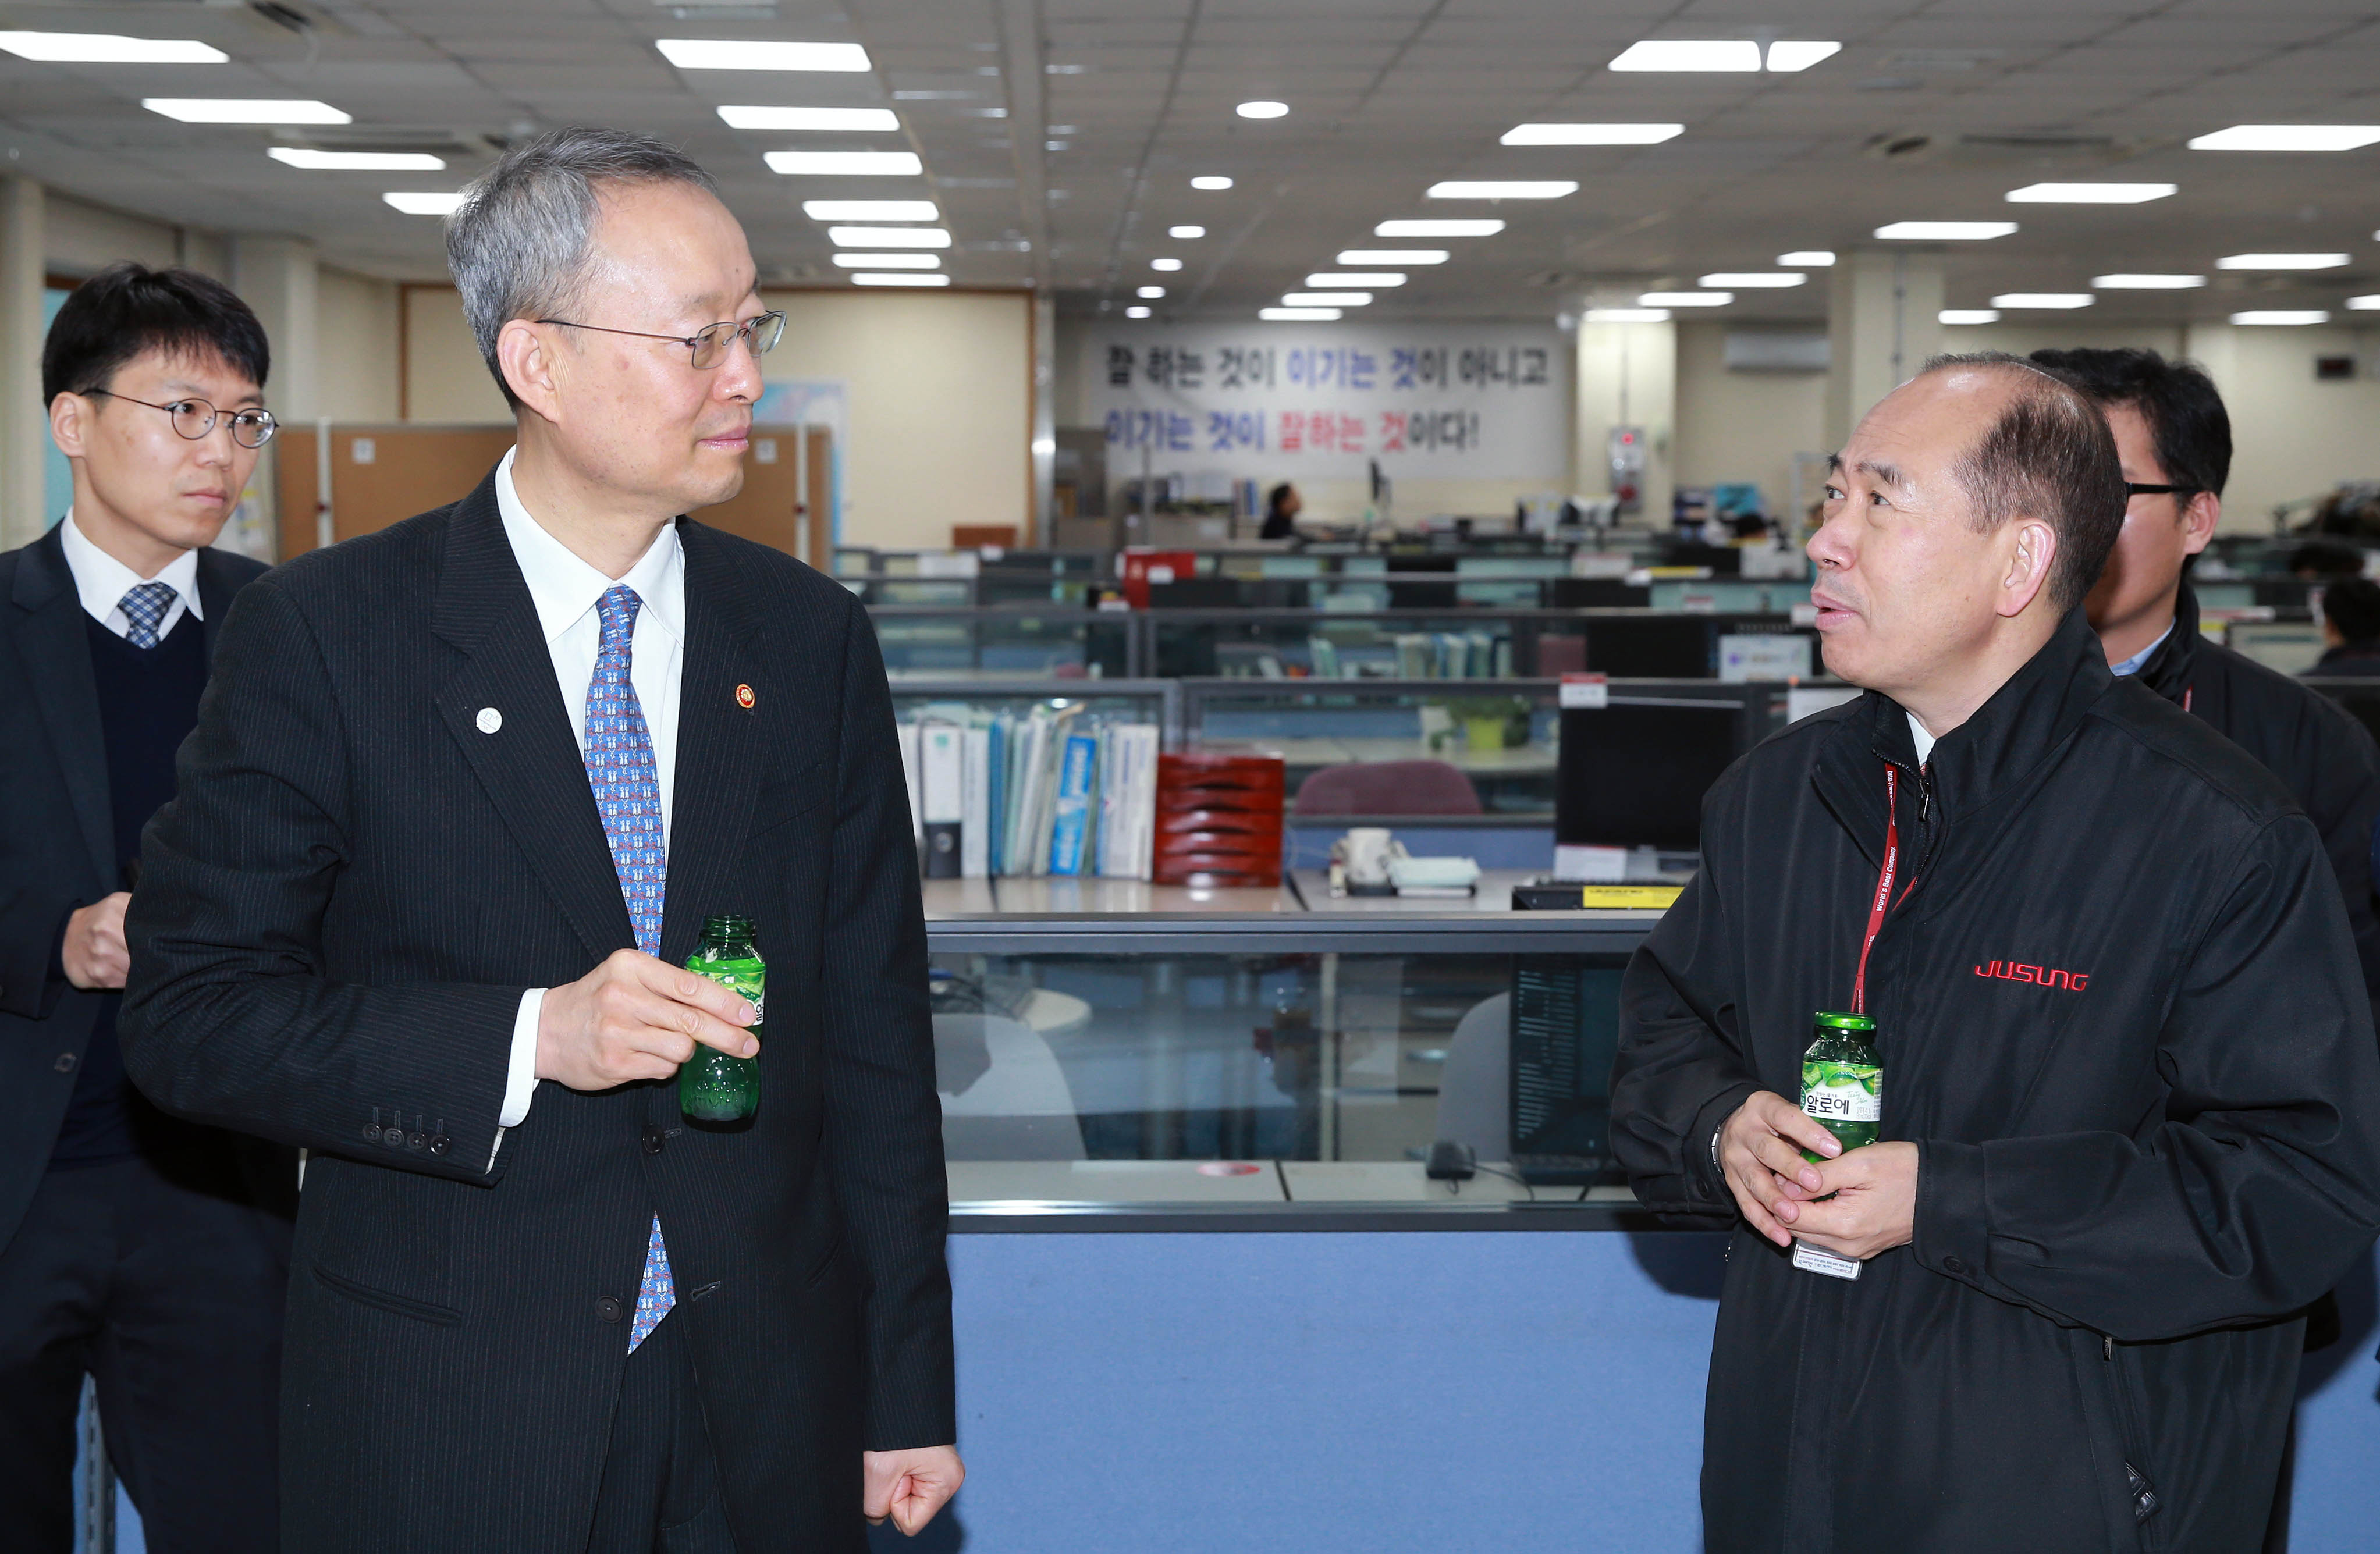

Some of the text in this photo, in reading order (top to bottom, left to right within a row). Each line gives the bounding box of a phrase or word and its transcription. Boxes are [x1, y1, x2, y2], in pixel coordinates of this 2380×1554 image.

[1107, 347, 1548, 389] 잘 하는 것이 이기는 것이 아니고
[1107, 408, 1479, 453] 이기는 것이 잘하는 것이다!
[1876, 888, 1888, 911] World's
[1882, 873, 1892, 887] Best
[1974, 960, 2090, 991] JUSUNG
[1807, 1094, 1849, 1115] 알로에
